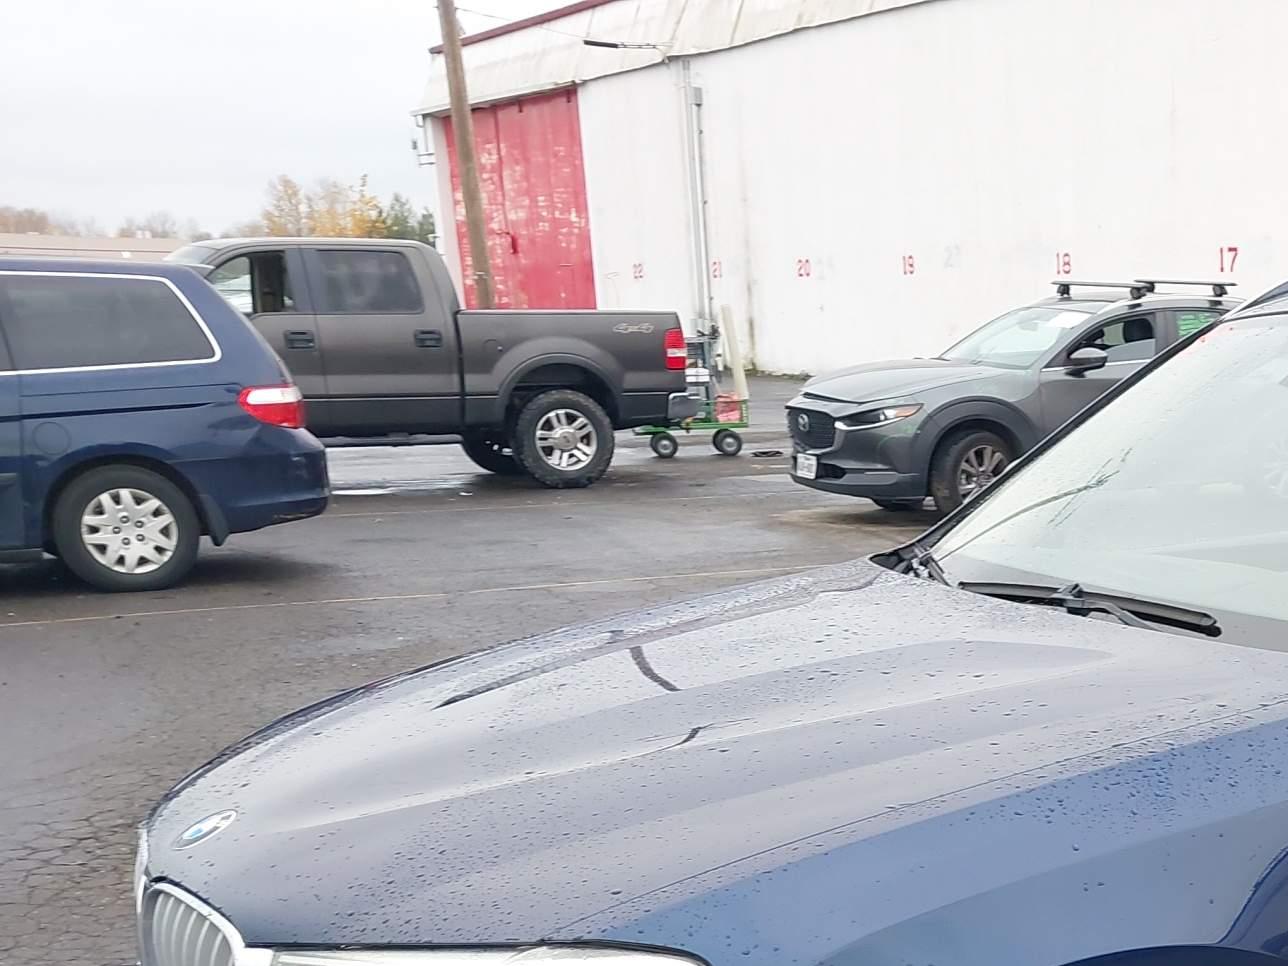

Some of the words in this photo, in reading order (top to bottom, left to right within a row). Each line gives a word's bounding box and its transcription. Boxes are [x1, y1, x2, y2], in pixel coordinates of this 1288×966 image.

[795, 258, 812, 278] 20
[902, 254, 916, 276] 19
[1056, 252, 1072, 275] 18
[1219, 247, 1239, 273] 17
